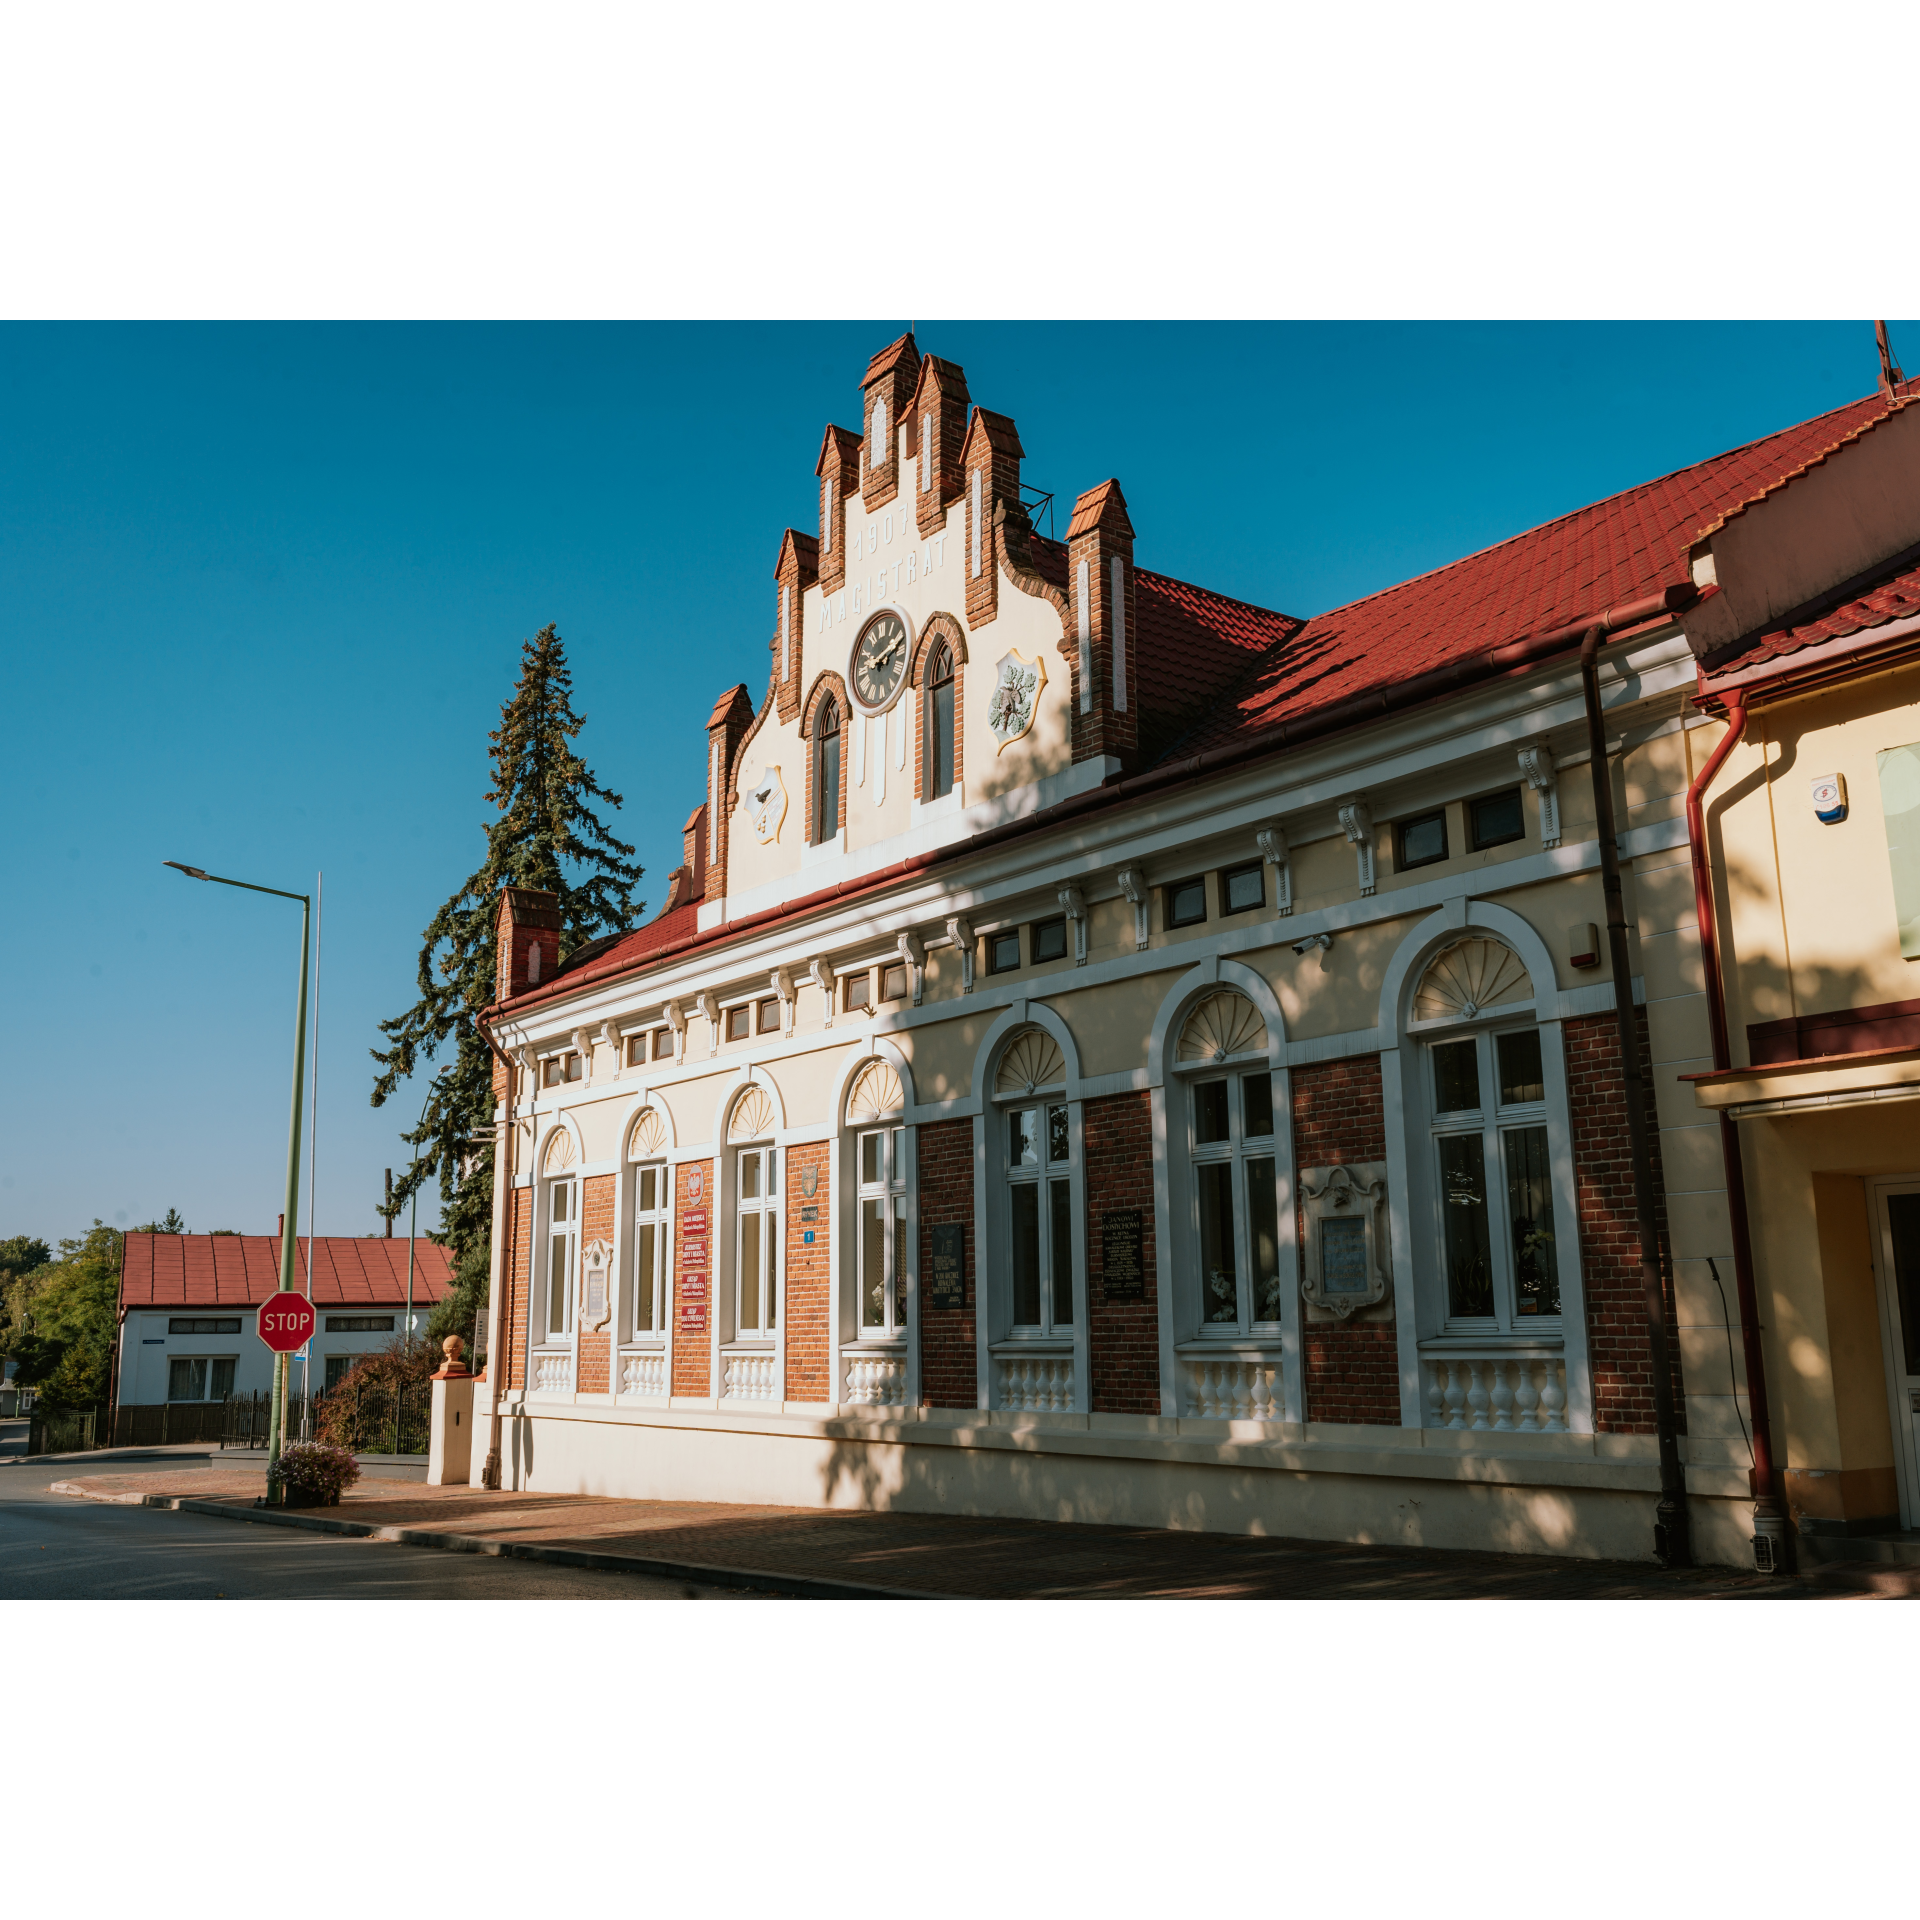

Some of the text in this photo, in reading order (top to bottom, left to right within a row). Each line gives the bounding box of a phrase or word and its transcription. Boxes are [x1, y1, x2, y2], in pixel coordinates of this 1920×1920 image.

[853, 502, 909, 561] 1907
[818, 533, 948, 634] MAGISTRAT
[803, 1210, 818, 1218] RYNEK
[264, 1312, 310, 1332] STOP
